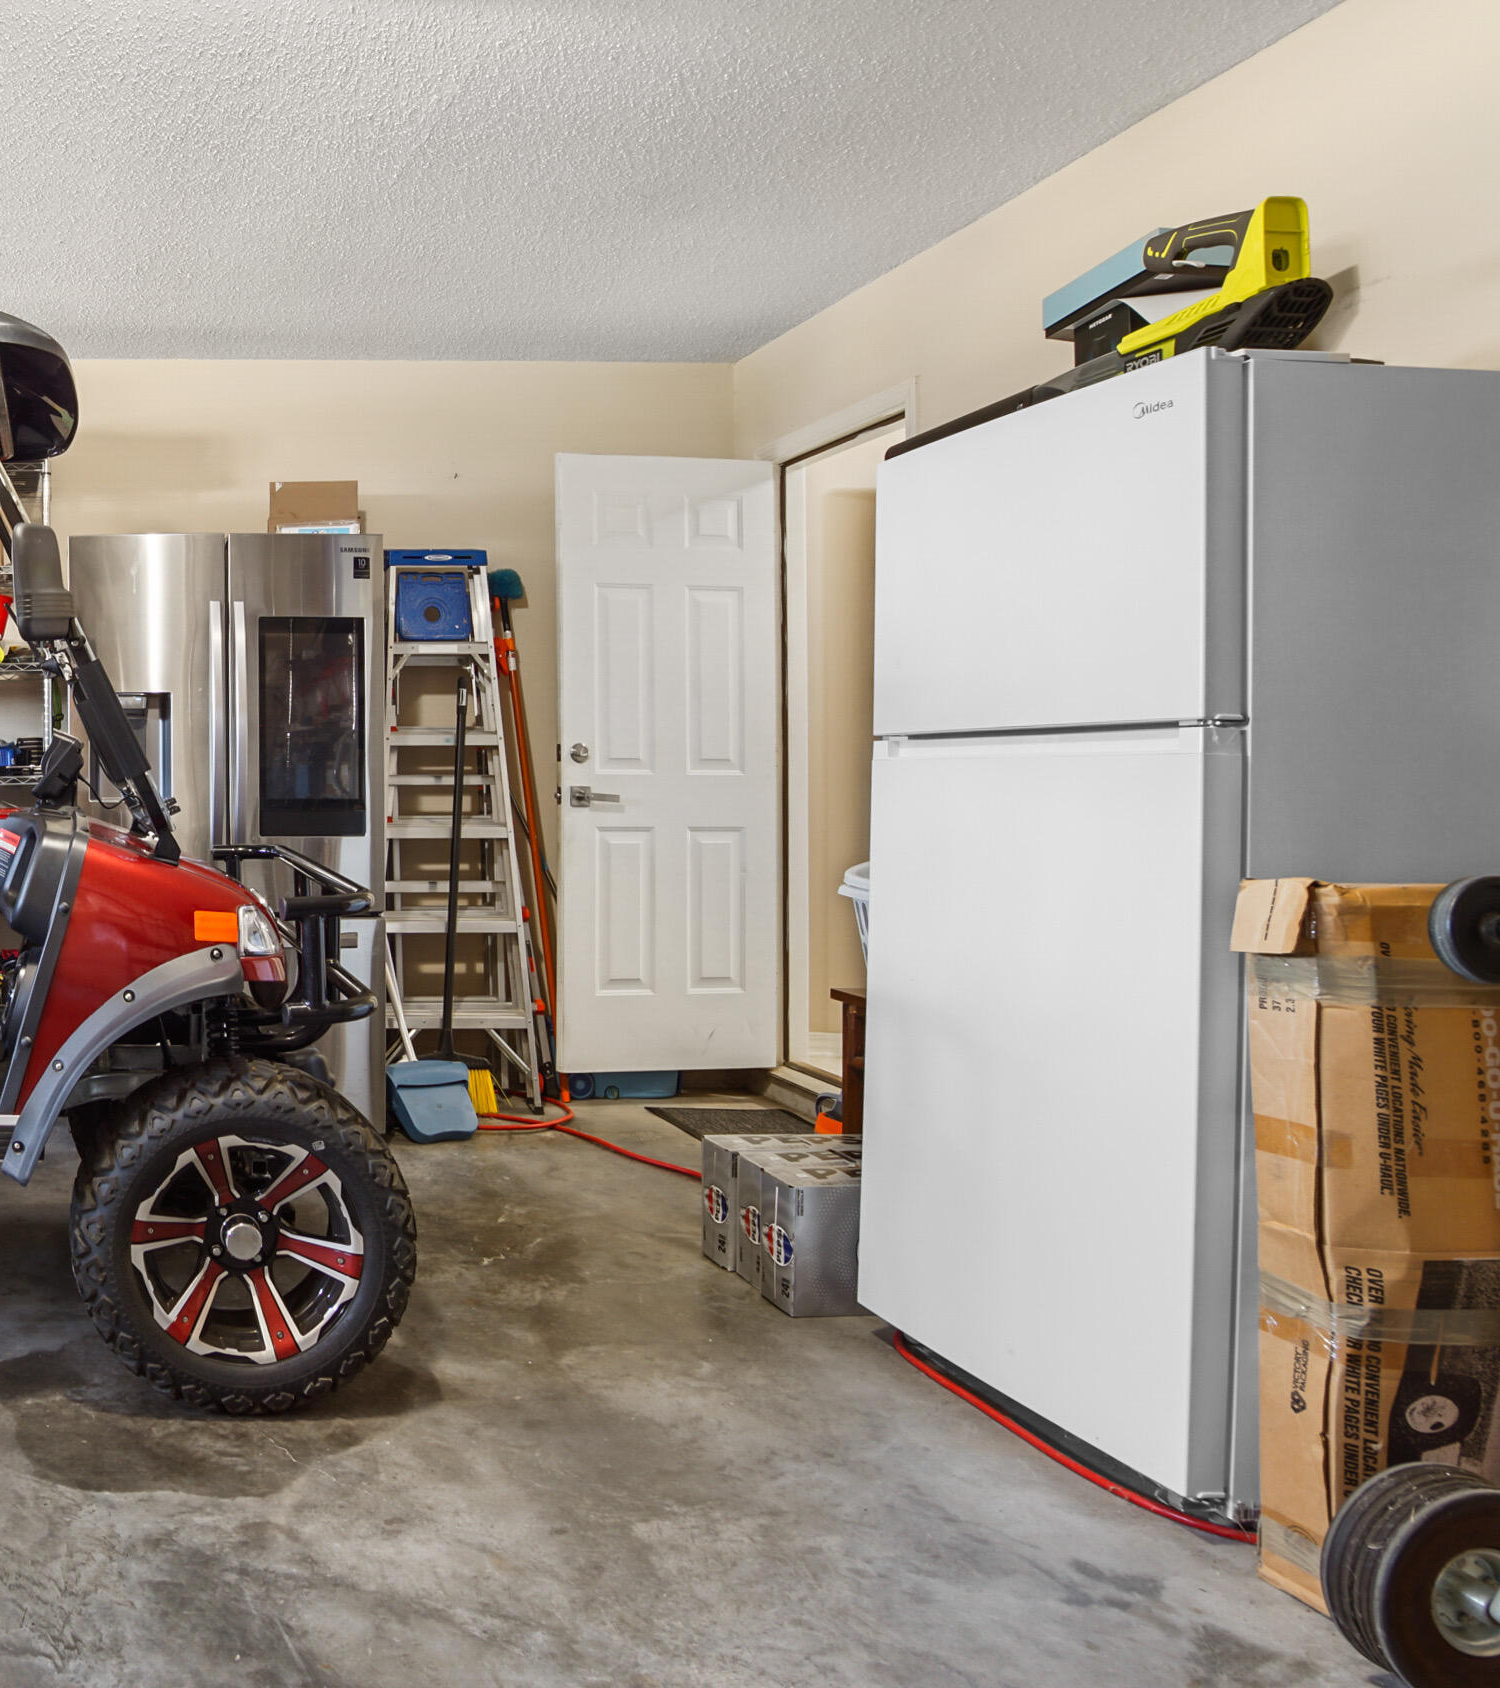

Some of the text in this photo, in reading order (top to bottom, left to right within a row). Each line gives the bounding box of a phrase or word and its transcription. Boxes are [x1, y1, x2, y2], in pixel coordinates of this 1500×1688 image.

[1126, 352, 1161, 372] RYOBI
[1132, 400, 1174, 420] Midea
[1373, 1037, 1388, 1072] WHITE
[1386, 1014, 1402, 1083] CONVENIENT
[1375, 1074, 1390, 1110] PAGES
[1377, 1112, 1391, 1149] UNDER
[1391, 1085, 1405, 1146] LOCATIONS
[1366, 1267, 1385, 1305] OVER
[1292, 1346, 1302, 1390] VICTORY
[1298, 1339, 1310, 1392] PACKAGING
[1345, 1353, 1362, 1395] WHITE
[1363, 1355, 1381, 1437] CONVENIENT
[1344, 1397, 1360, 1441] PAGES
[1343, 1442, 1360, 1487] UNDER
